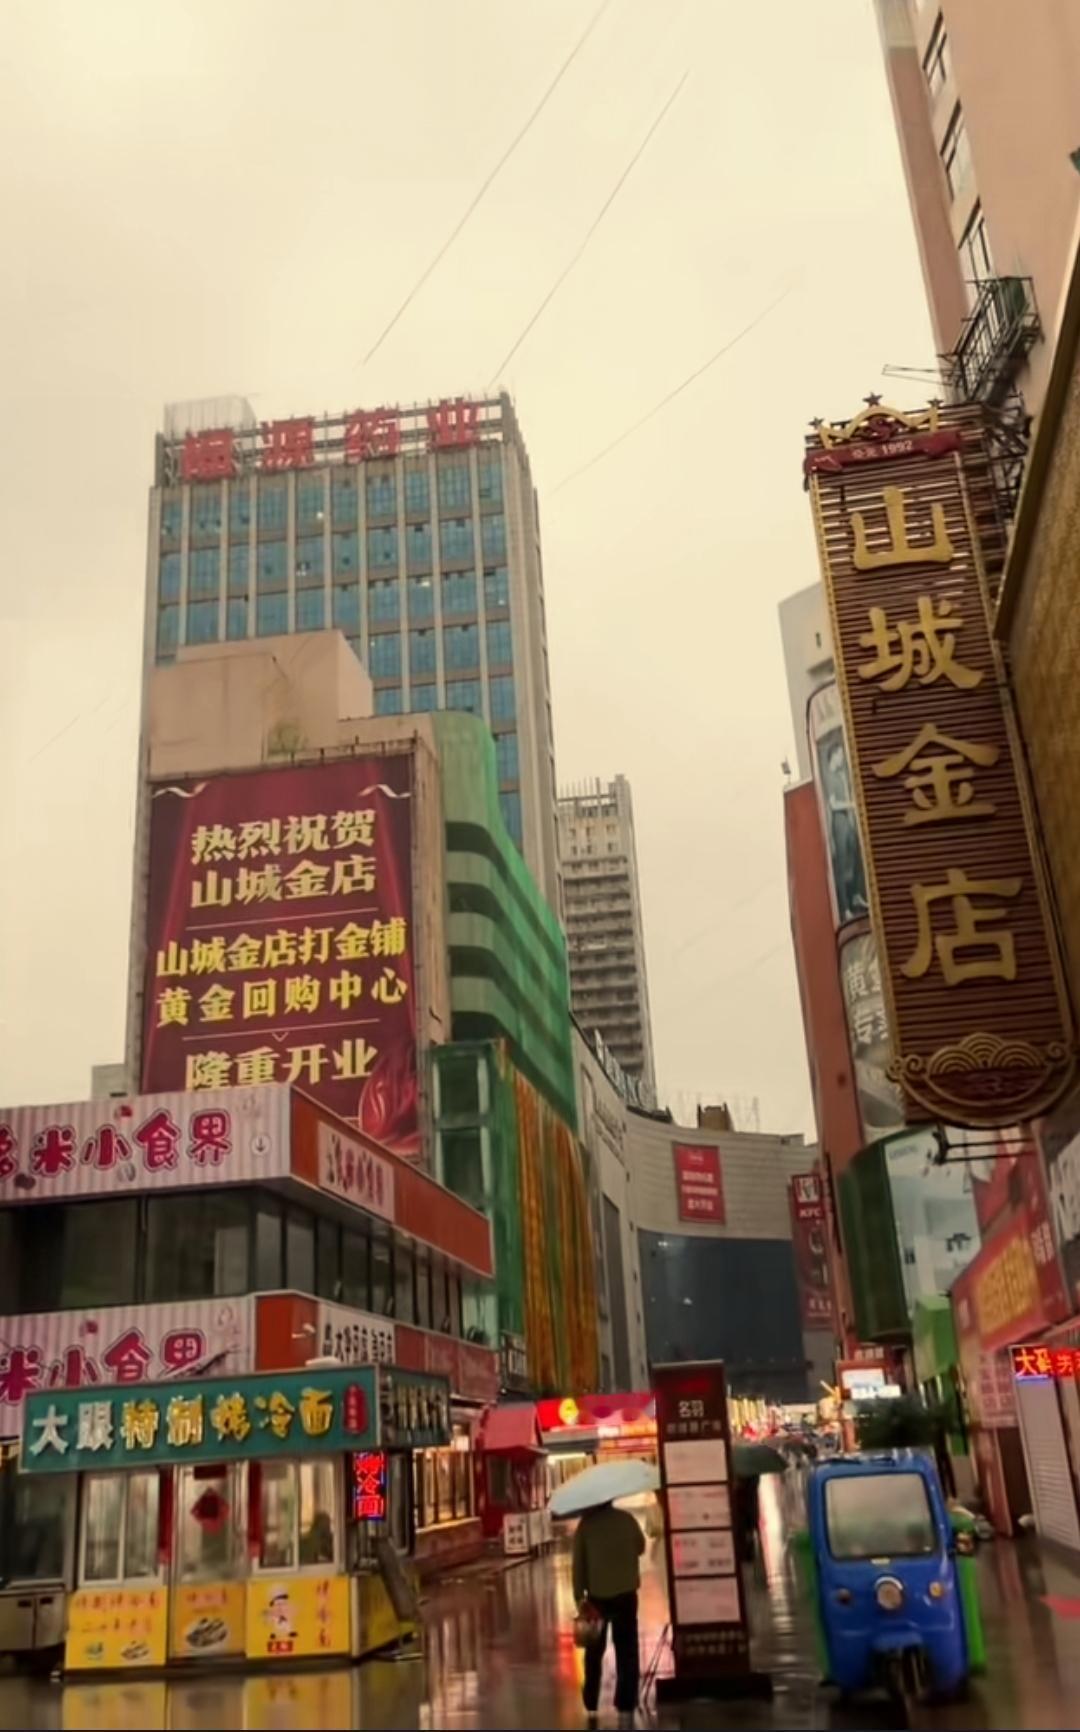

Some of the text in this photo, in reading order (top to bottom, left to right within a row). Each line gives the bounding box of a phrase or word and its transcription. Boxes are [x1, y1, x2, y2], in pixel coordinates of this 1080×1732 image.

[850, 484, 1024, 987] 山城金店
[190, 809, 377, 865] 热烈祝贺
[190, 854, 377, 909] 山城金店
[156, 916, 408, 979] 山城金店打金铺
[156, 967, 408, 1029] 黄金回购中心
[185, 1037, 378, 1093] 隆重开业
